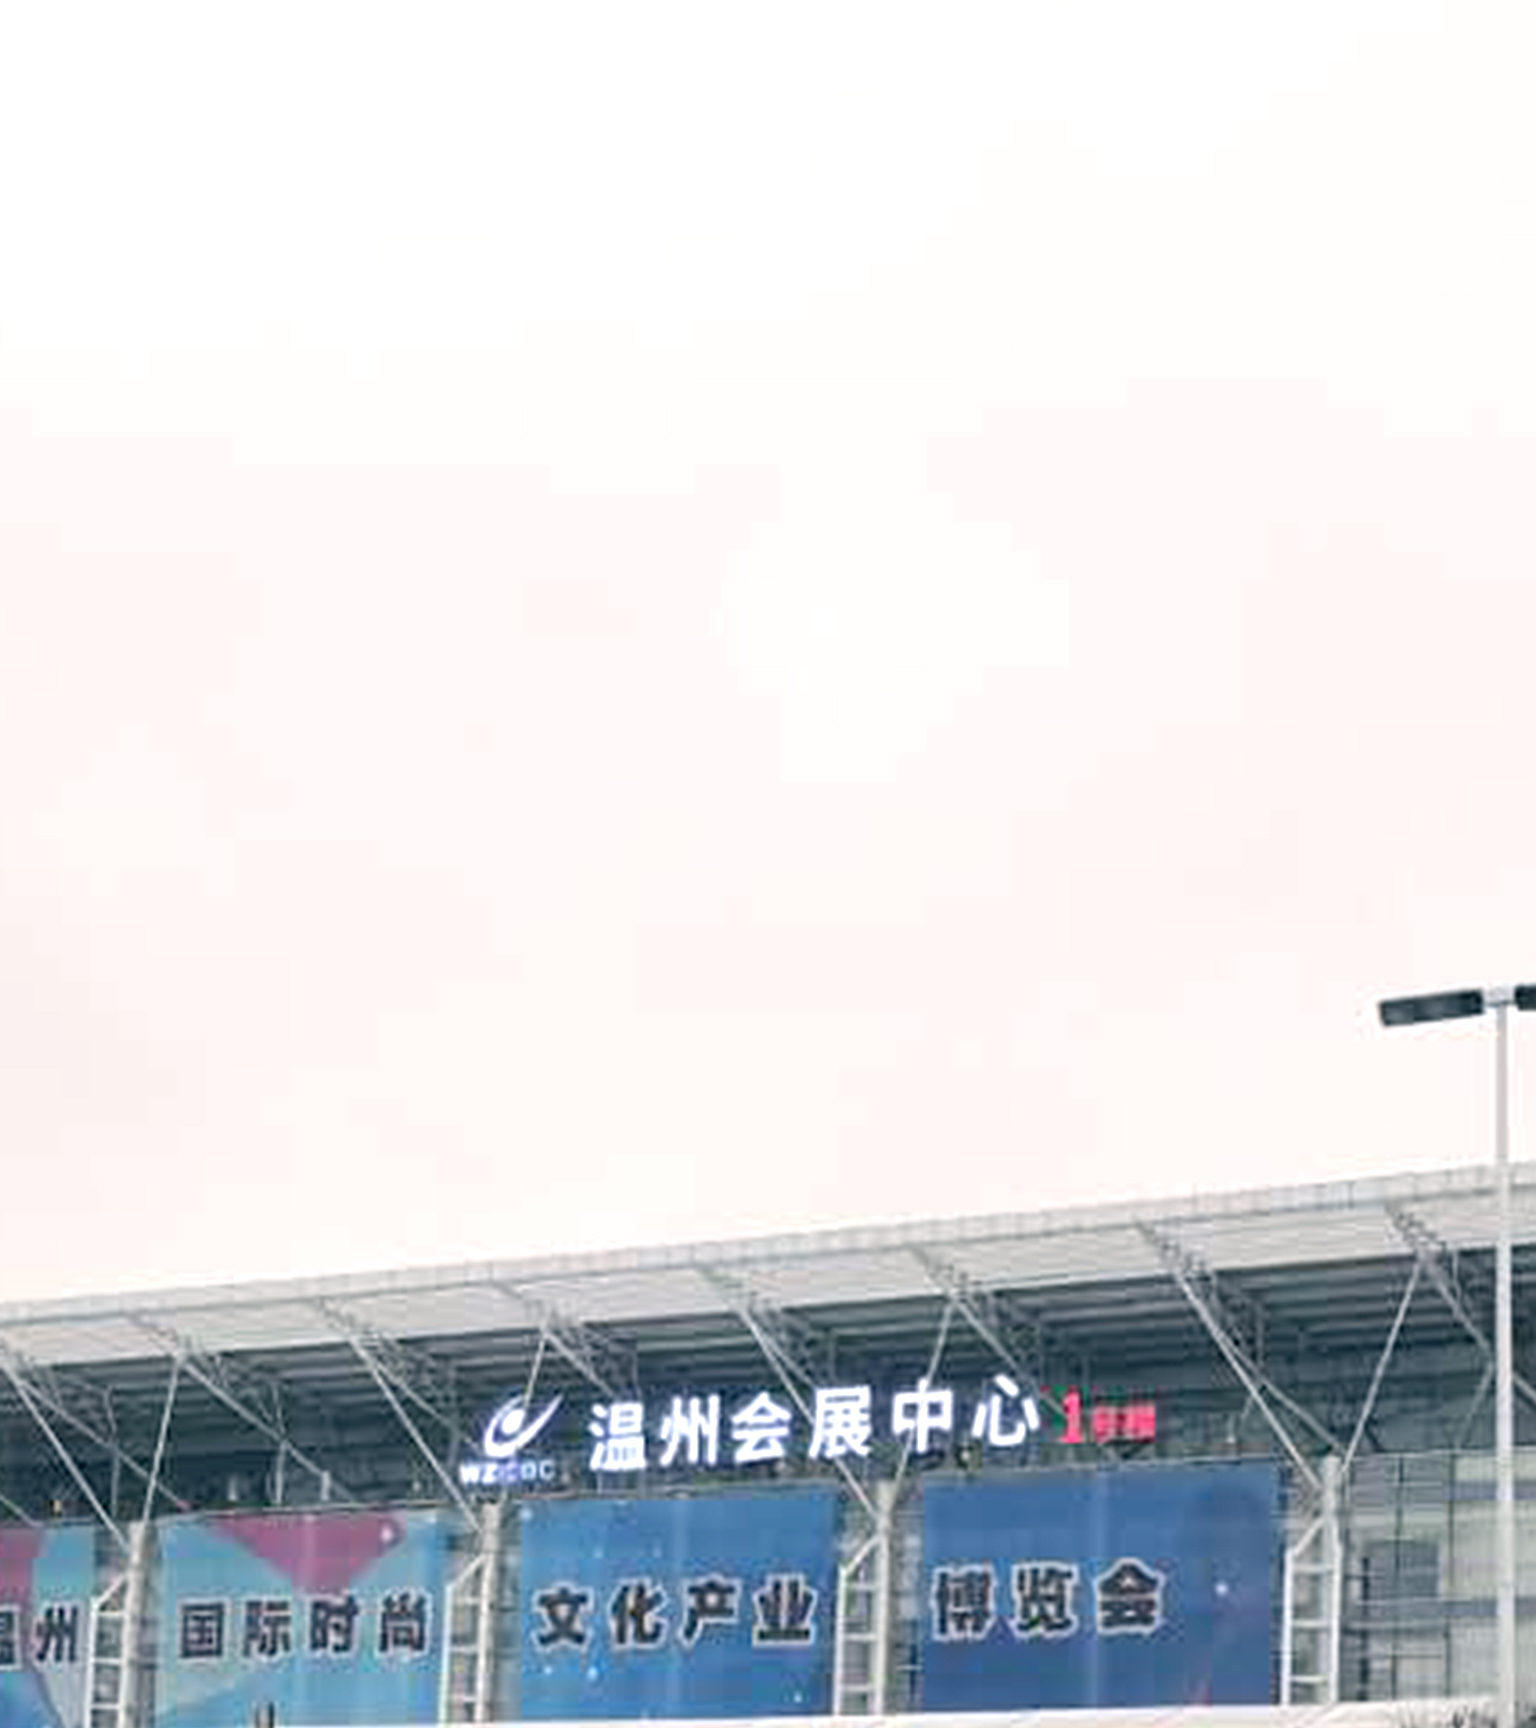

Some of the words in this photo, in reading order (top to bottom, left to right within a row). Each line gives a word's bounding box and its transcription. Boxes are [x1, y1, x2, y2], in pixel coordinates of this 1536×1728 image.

[588, 1374, 1040, 1471] 温州会展中心
